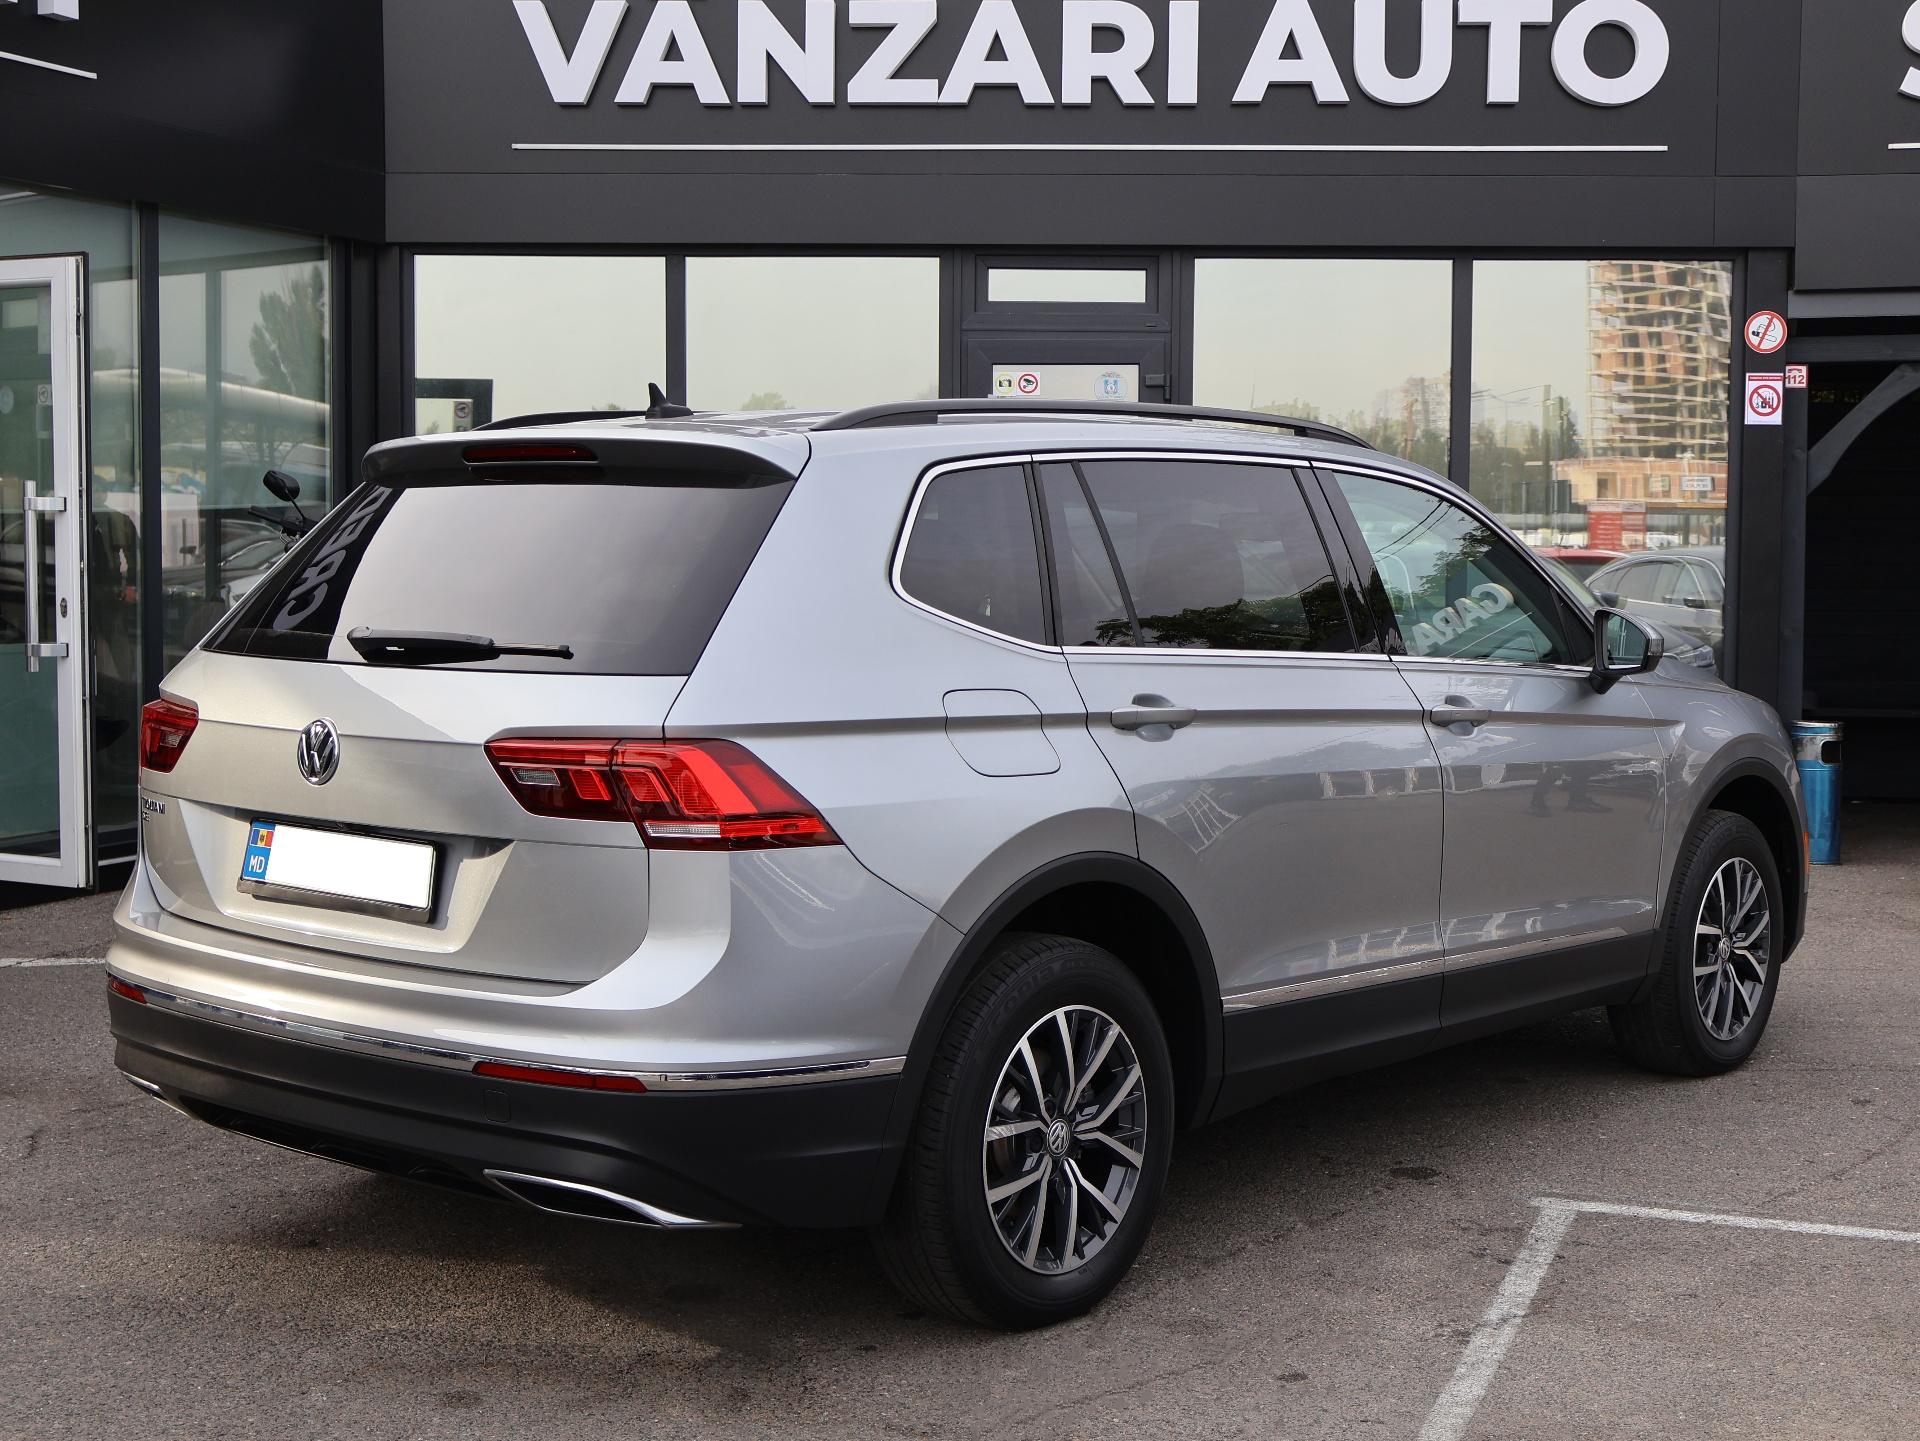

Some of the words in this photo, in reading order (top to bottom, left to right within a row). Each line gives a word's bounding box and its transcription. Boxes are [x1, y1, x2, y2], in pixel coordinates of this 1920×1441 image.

[1232, 0, 1670, 106] AUTO
[1786, 374, 1805, 385] 112
[248, 854, 265, 873] MD
